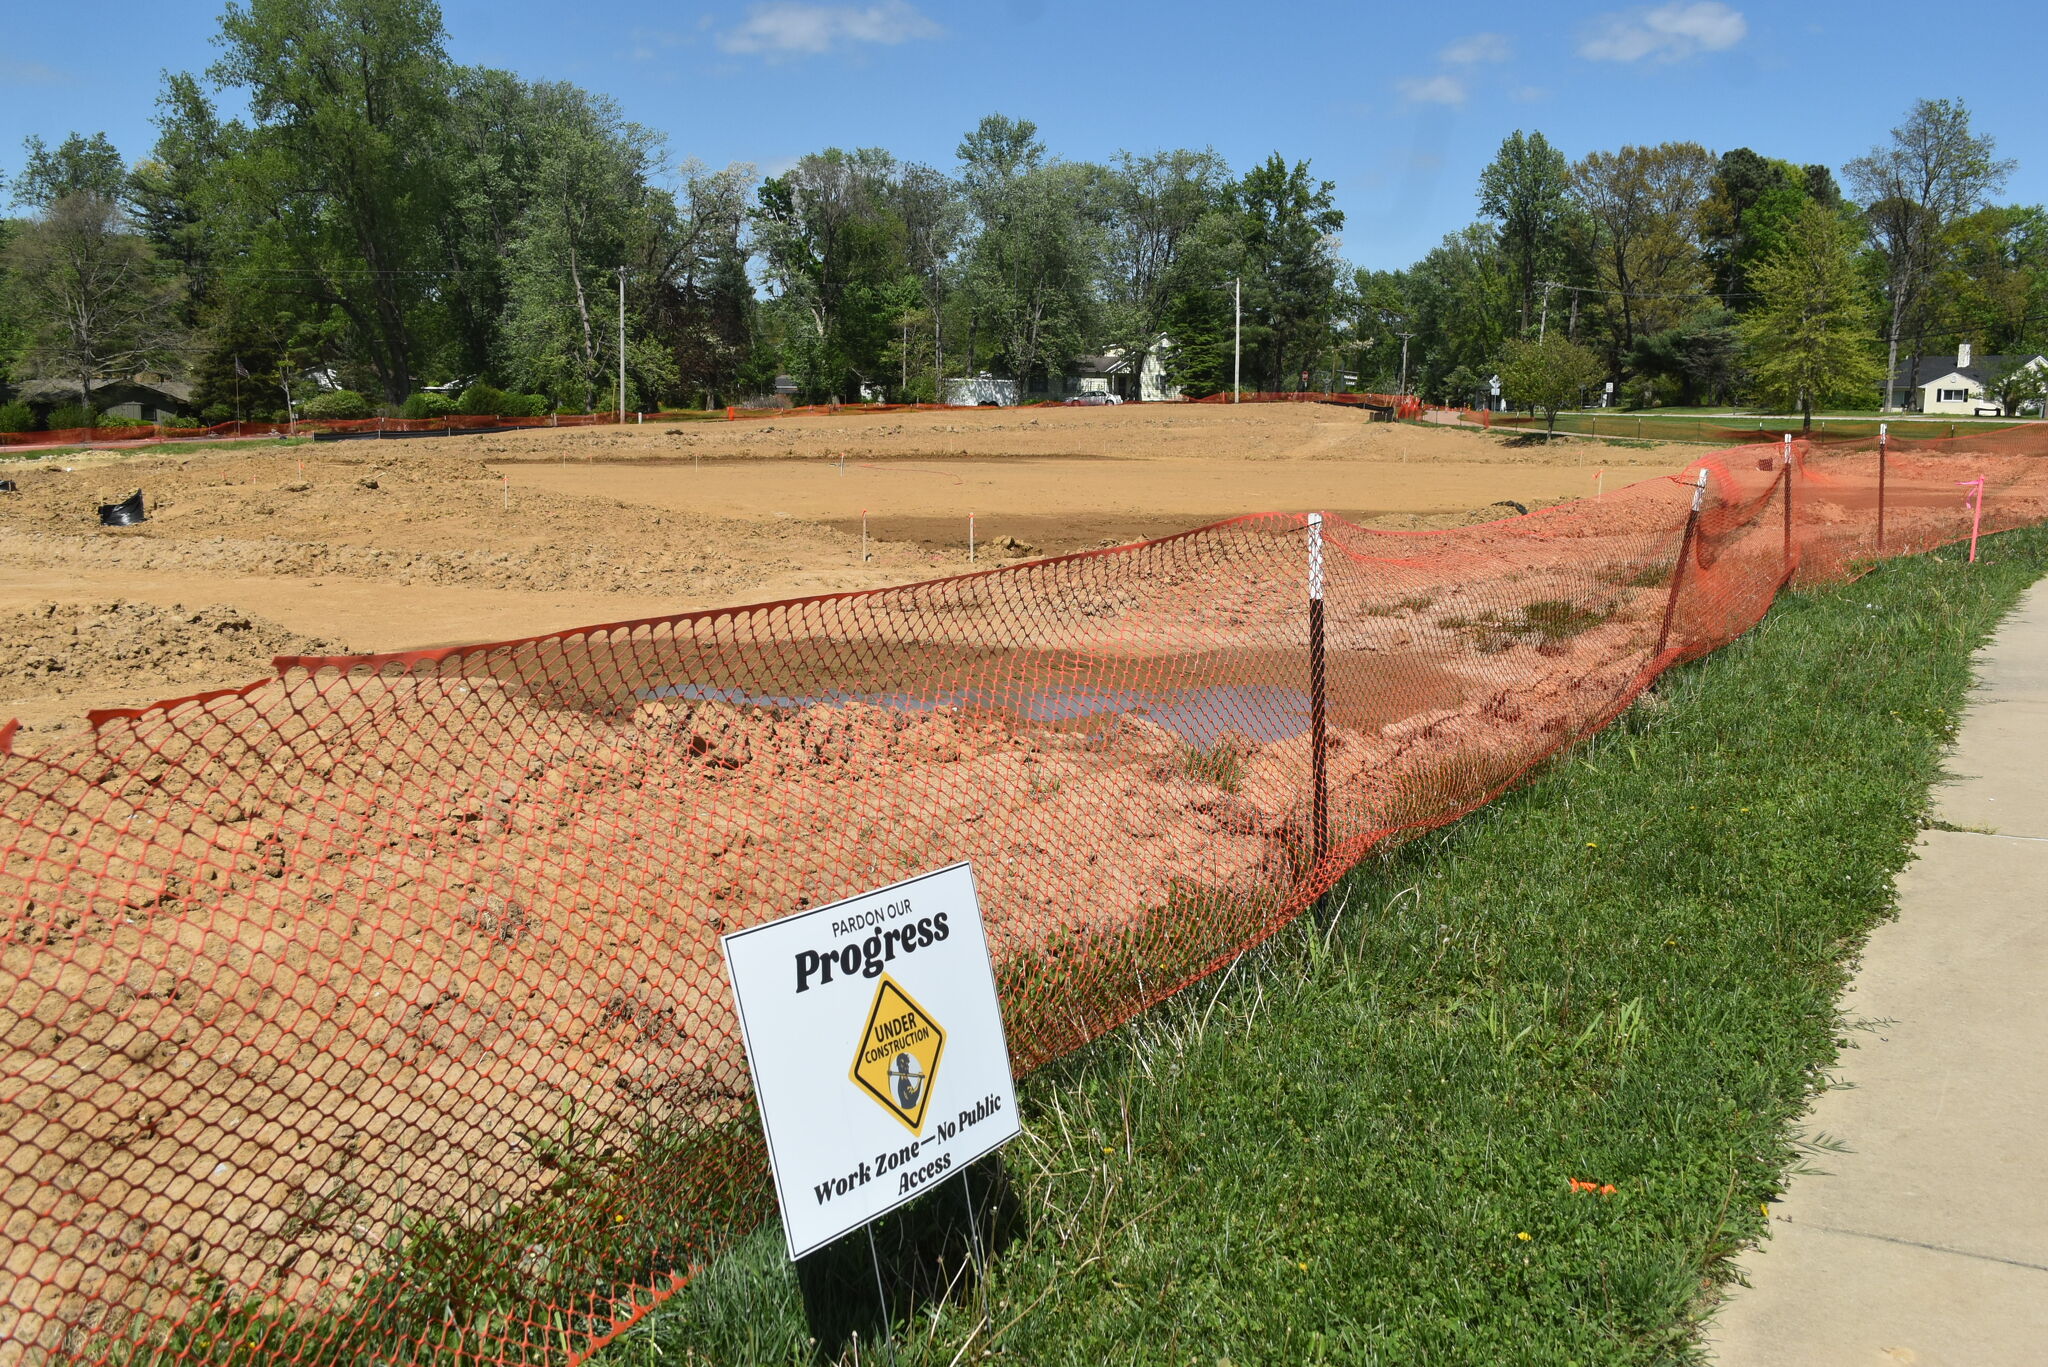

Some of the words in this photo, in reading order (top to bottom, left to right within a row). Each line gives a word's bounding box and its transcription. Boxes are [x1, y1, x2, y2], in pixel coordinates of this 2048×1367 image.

[832, 907, 885, 937] PARDON
[887, 899, 912, 919] OUR
[795, 912, 949, 993] Progress
[865, 1026, 929, 1064] CONSTRUCTION
[875, 1012, 917, 1042] UNDER
[814, 1162, 871, 1206] Work
[958, 1093, 1002, 1133] Public
[898, 1152, 951, 1196] Access
